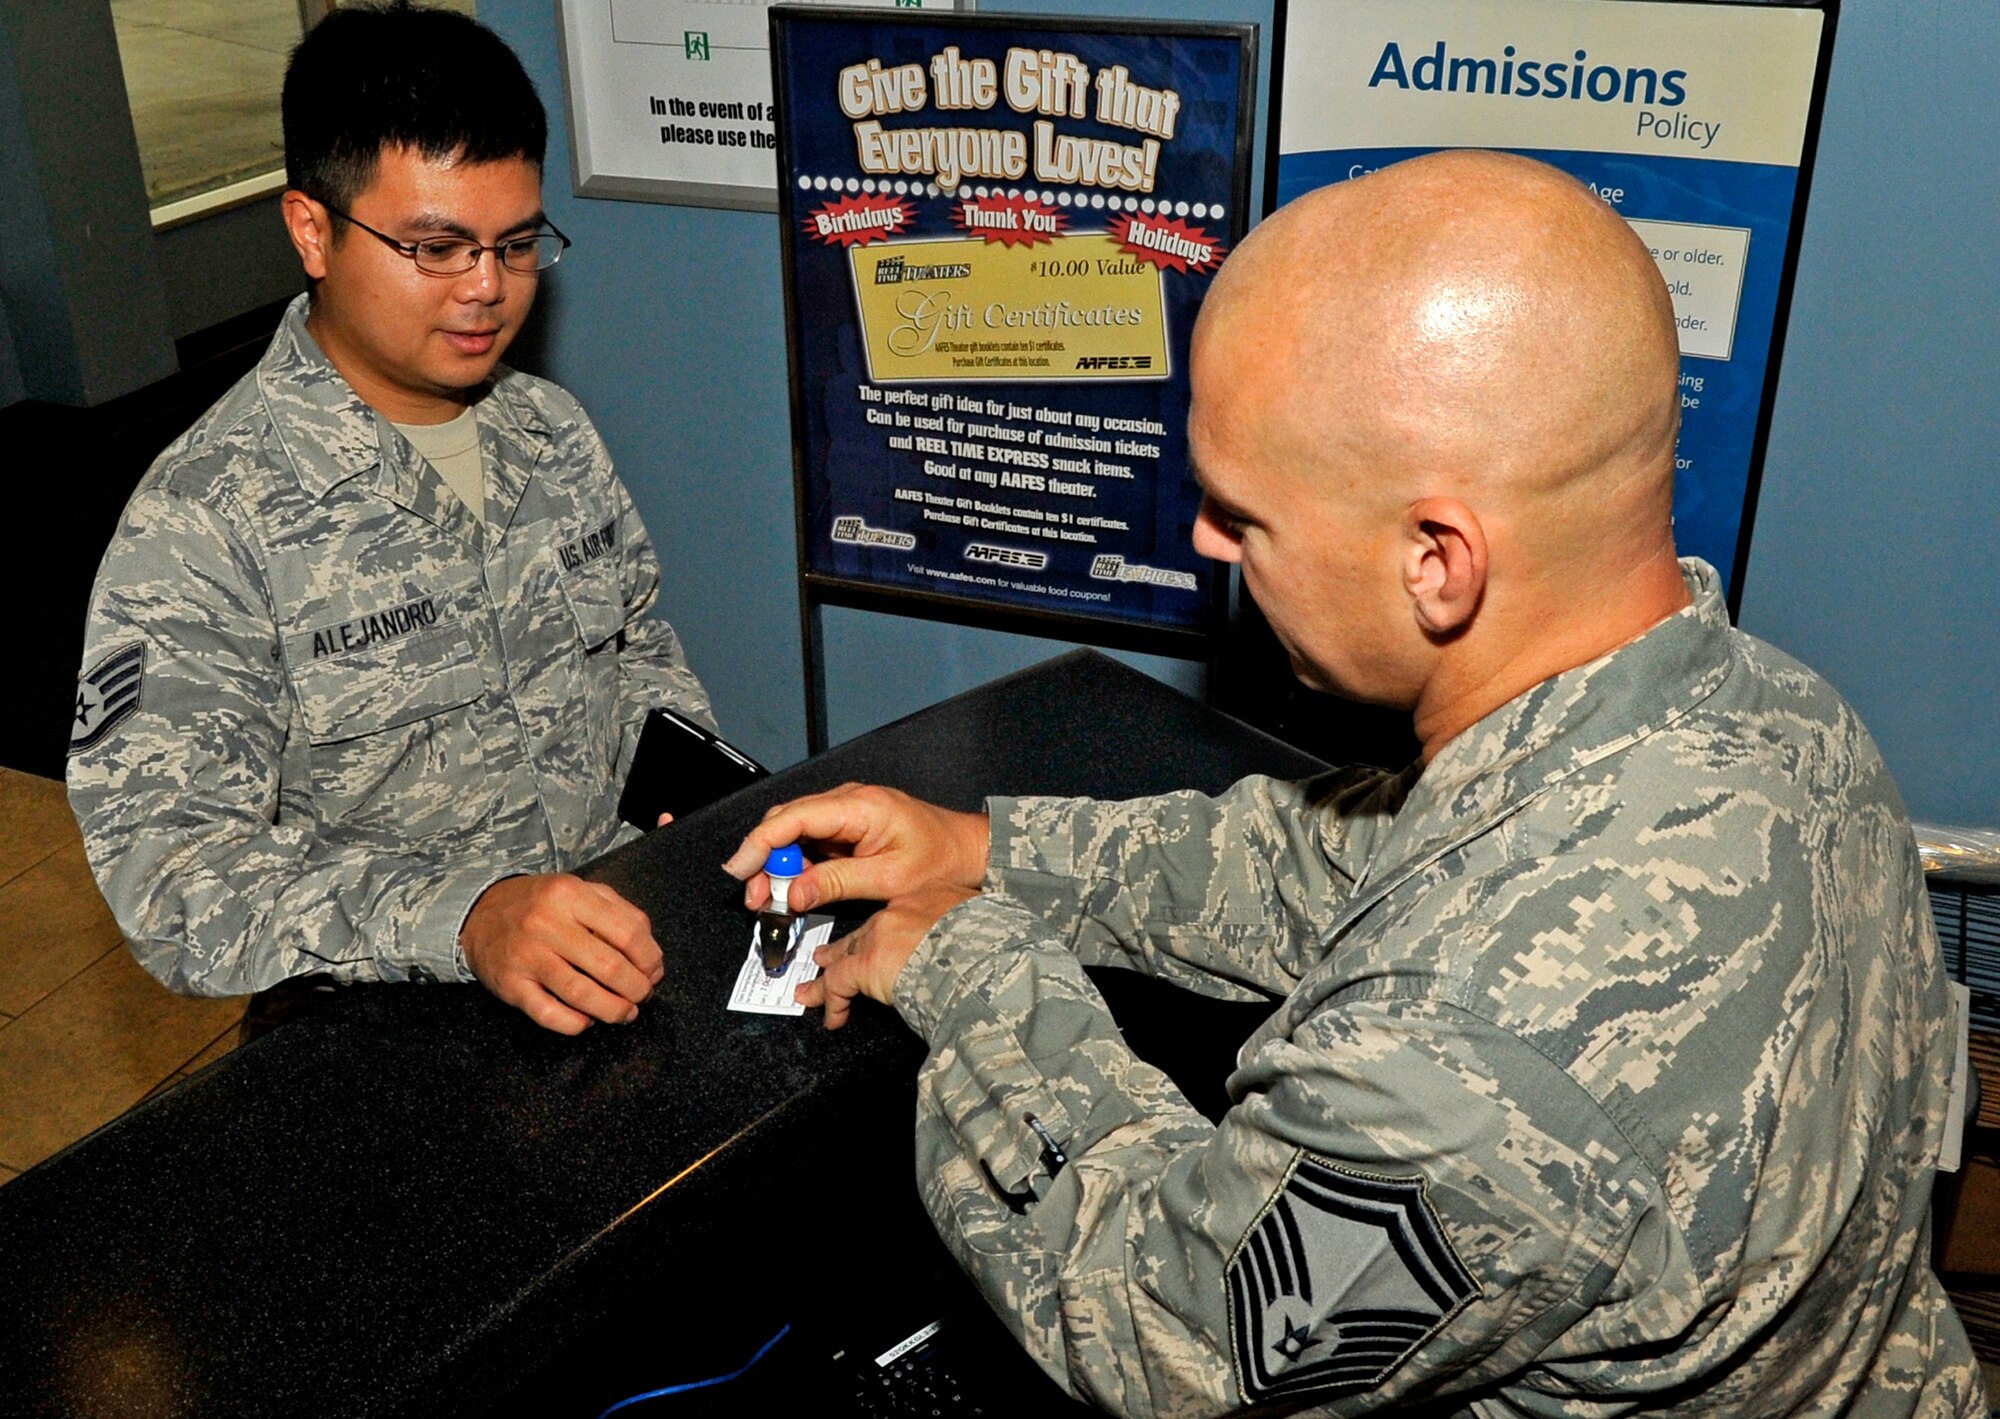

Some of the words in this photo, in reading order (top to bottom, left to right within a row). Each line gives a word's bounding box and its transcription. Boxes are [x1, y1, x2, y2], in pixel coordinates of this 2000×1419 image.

[1368, 41, 1687, 106] Admissions
[650, 96, 666, 115] In
[669, 98, 695, 117] the
[699, 101, 743, 120] event
[747, 103, 763, 121] of
[766, 106, 775, 122] a
[839, 59, 926, 118] Give
[931, 46, 998, 110] the
[1006, 47, 1089, 118] Gift
[1096, 65, 1180, 139] that
[661, 124, 713, 146] please
[717, 131, 746, 148] use
[750, 129, 776, 149] the
[1636, 111, 1721, 149] Policy
[855, 120, 1027, 191] Everyone
[1033, 120, 1160, 193] Loves!
[815, 204, 904, 237] Birthdays
[962, 202, 1016, 230] Thank
[1021, 207, 1057, 233] You
[1127, 220, 1212, 264] Holidays
[1663, 250, 1679, 261] or
[1683, 249, 1725, 266] older.
[1030, 259, 1090, 277] $10.00
[1096, 258, 1146, 276] Value
[1666, 280, 1692, 296] old.
[888, 290, 974, 357] Gift
[984, 301, 1142, 329] Certificates
[1674, 315, 1708, 331] nder.
[935, 341, 950, 352] AAFES
[950, 341, 969, 352] Theater
[969, 341, 978, 354] gift
[978, 341, 1000, 352] booklets
[1000, 341, 1019, 352] contain
[1020, 342, 1028, 352] ten
[952, 356, 975, 368] Purchase
[975, 356, 984, 367] Gift
[984, 356, 1012, 367] Certificates
[1018, 356, 1028, 367] this
[1076, 357, 1131, 369] AAFES
[858, 385, 882, 402] The
[884, 390, 928, 407] perfect
[931, 394, 953, 411] gift
[957, 396, 983, 414] idea
[986, 400, 1005, 416] for
[1006, 402, 1032, 420] just
[1035, 407, 1072, 426] about
[1075, 414, 1100, 432] any
[1103, 417, 1168, 436] occasion.
[1681, 393, 1700, 409] be
[866, 408, 892, 426] Can
[895, 411, 911, 428] be
[914, 416, 943, 432] used
[946, 418, 965, 434] for
[967, 424, 1025, 443] purchase
[1028, 429, 1044, 445] of
[1044, 432, 1112, 454] admission
[1115, 439, 1160, 459] tickets
[889, 436, 912, 450] and
[915, 436, 949, 455] REEL
[950, 440, 984, 460] TIME
[986, 446, 1049, 469] EXPRESS
[1052, 457, 1091, 474] snack
[1094, 459, 1135, 479] items.
[924, 460, 956, 479] Good
[959, 466, 972, 480] at
[974, 470, 998, 488] any
[1000, 471, 1046, 491] AAFES
[1048, 478, 1097, 498] theater.
[894, 488, 924, 502] AAFES
[925, 492, 954, 507] Theater
[956, 497, 973, 511] Gift
[974, 501, 1011, 516] Booklets
[1013, 507, 1044, 521] contain
[1045, 511, 1059, 522] ten
[1076, 516, 1130, 531] certificates.
[923, 508, 961, 525] Purchase
[962, 514, 979, 527] Gift
[980, 518, 1030, 536] Certificates
[1031, 526, 1041, 537] at
[1042, 528, 1058, 539] this
[1060, 529, 1098, 544] location.
[582, 533, 604, 562] AIR
[966, 546, 1022, 564] AAFES
[907, 563, 924, 575] Visit
[926, 568, 997, 586] www.aafes.com
[997, 578, 1009, 588] for
[1010, 581, 1047, 594] valuable
[1048, 586, 1068, 597] food
[1070, 590, 1111, 602] coupons!
[313, 599, 437, 659] ALEJANDRO
